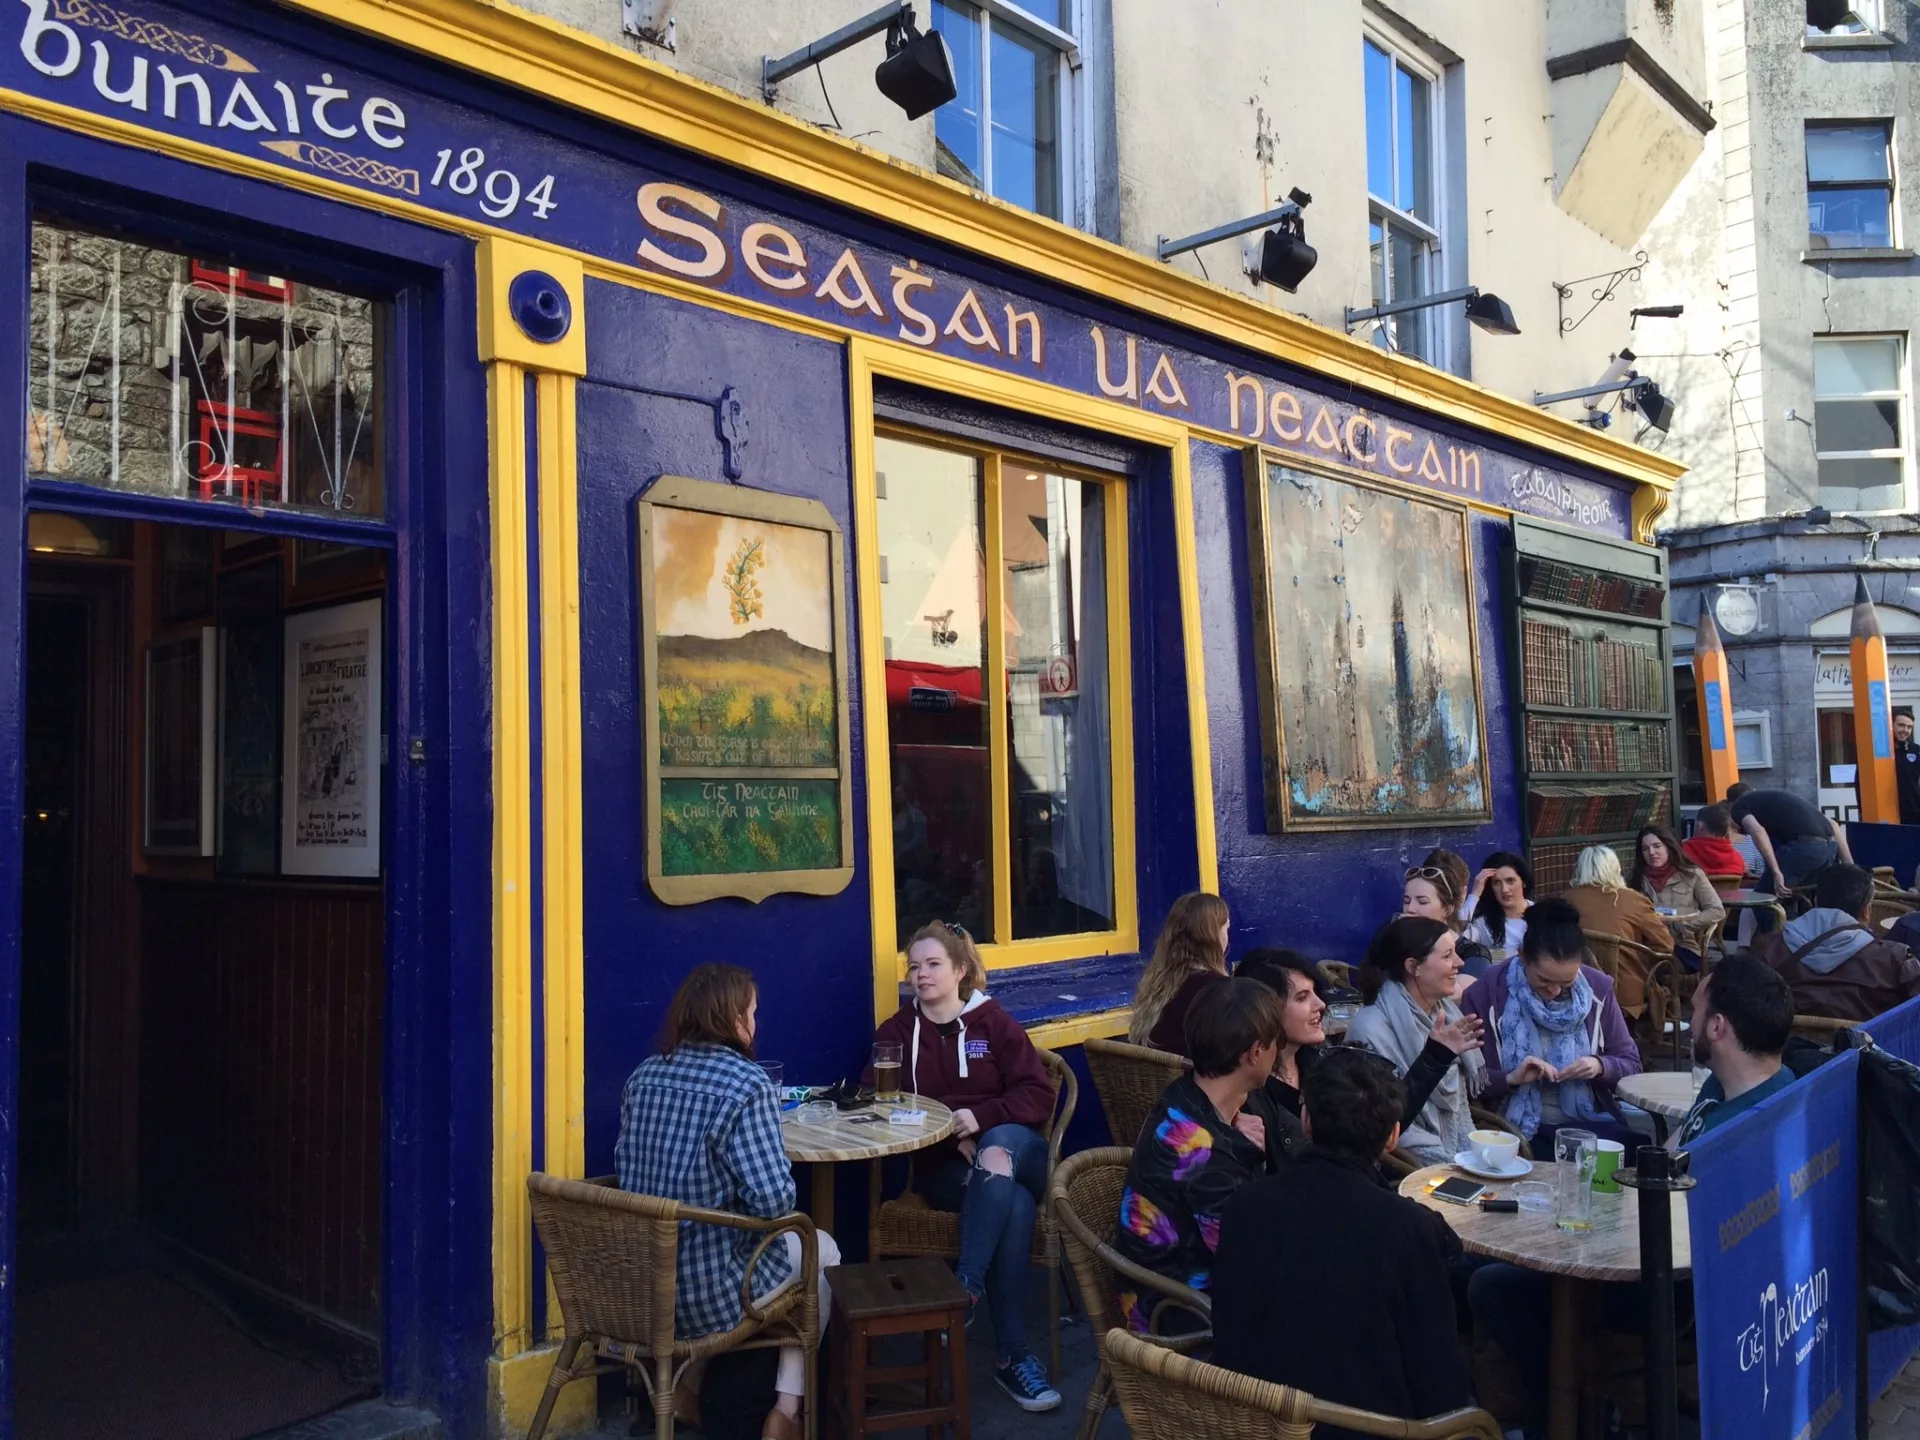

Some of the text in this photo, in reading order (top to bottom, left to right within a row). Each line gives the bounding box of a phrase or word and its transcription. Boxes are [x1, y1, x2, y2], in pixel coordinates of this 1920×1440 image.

[430, 147, 558, 220] 1894
[337, 663, 367, 680] THEATRE
[752, 749, 766, 764] of
